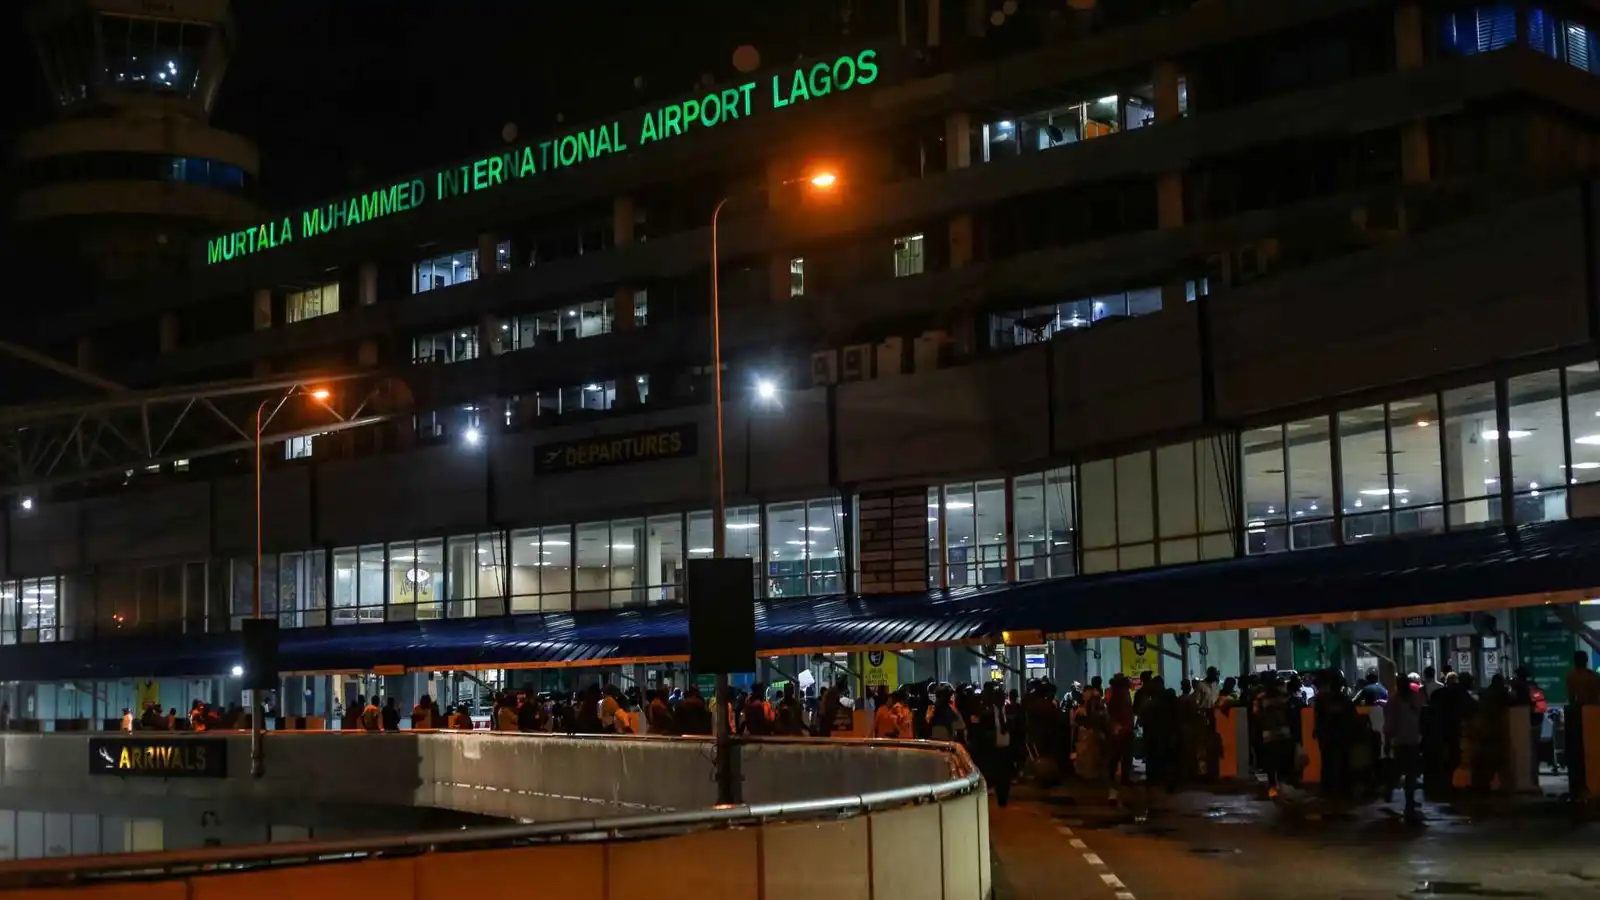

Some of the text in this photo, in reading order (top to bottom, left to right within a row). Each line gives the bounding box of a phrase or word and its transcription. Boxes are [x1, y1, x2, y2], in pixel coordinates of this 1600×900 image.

[207, 49, 879, 264] MURTALA MUHAMMED INTERNATIONAL AIRPORT LAGOS
[564, 431, 682, 467] DEPARTURES
[119, 746, 206, 769] ARRIVALS
